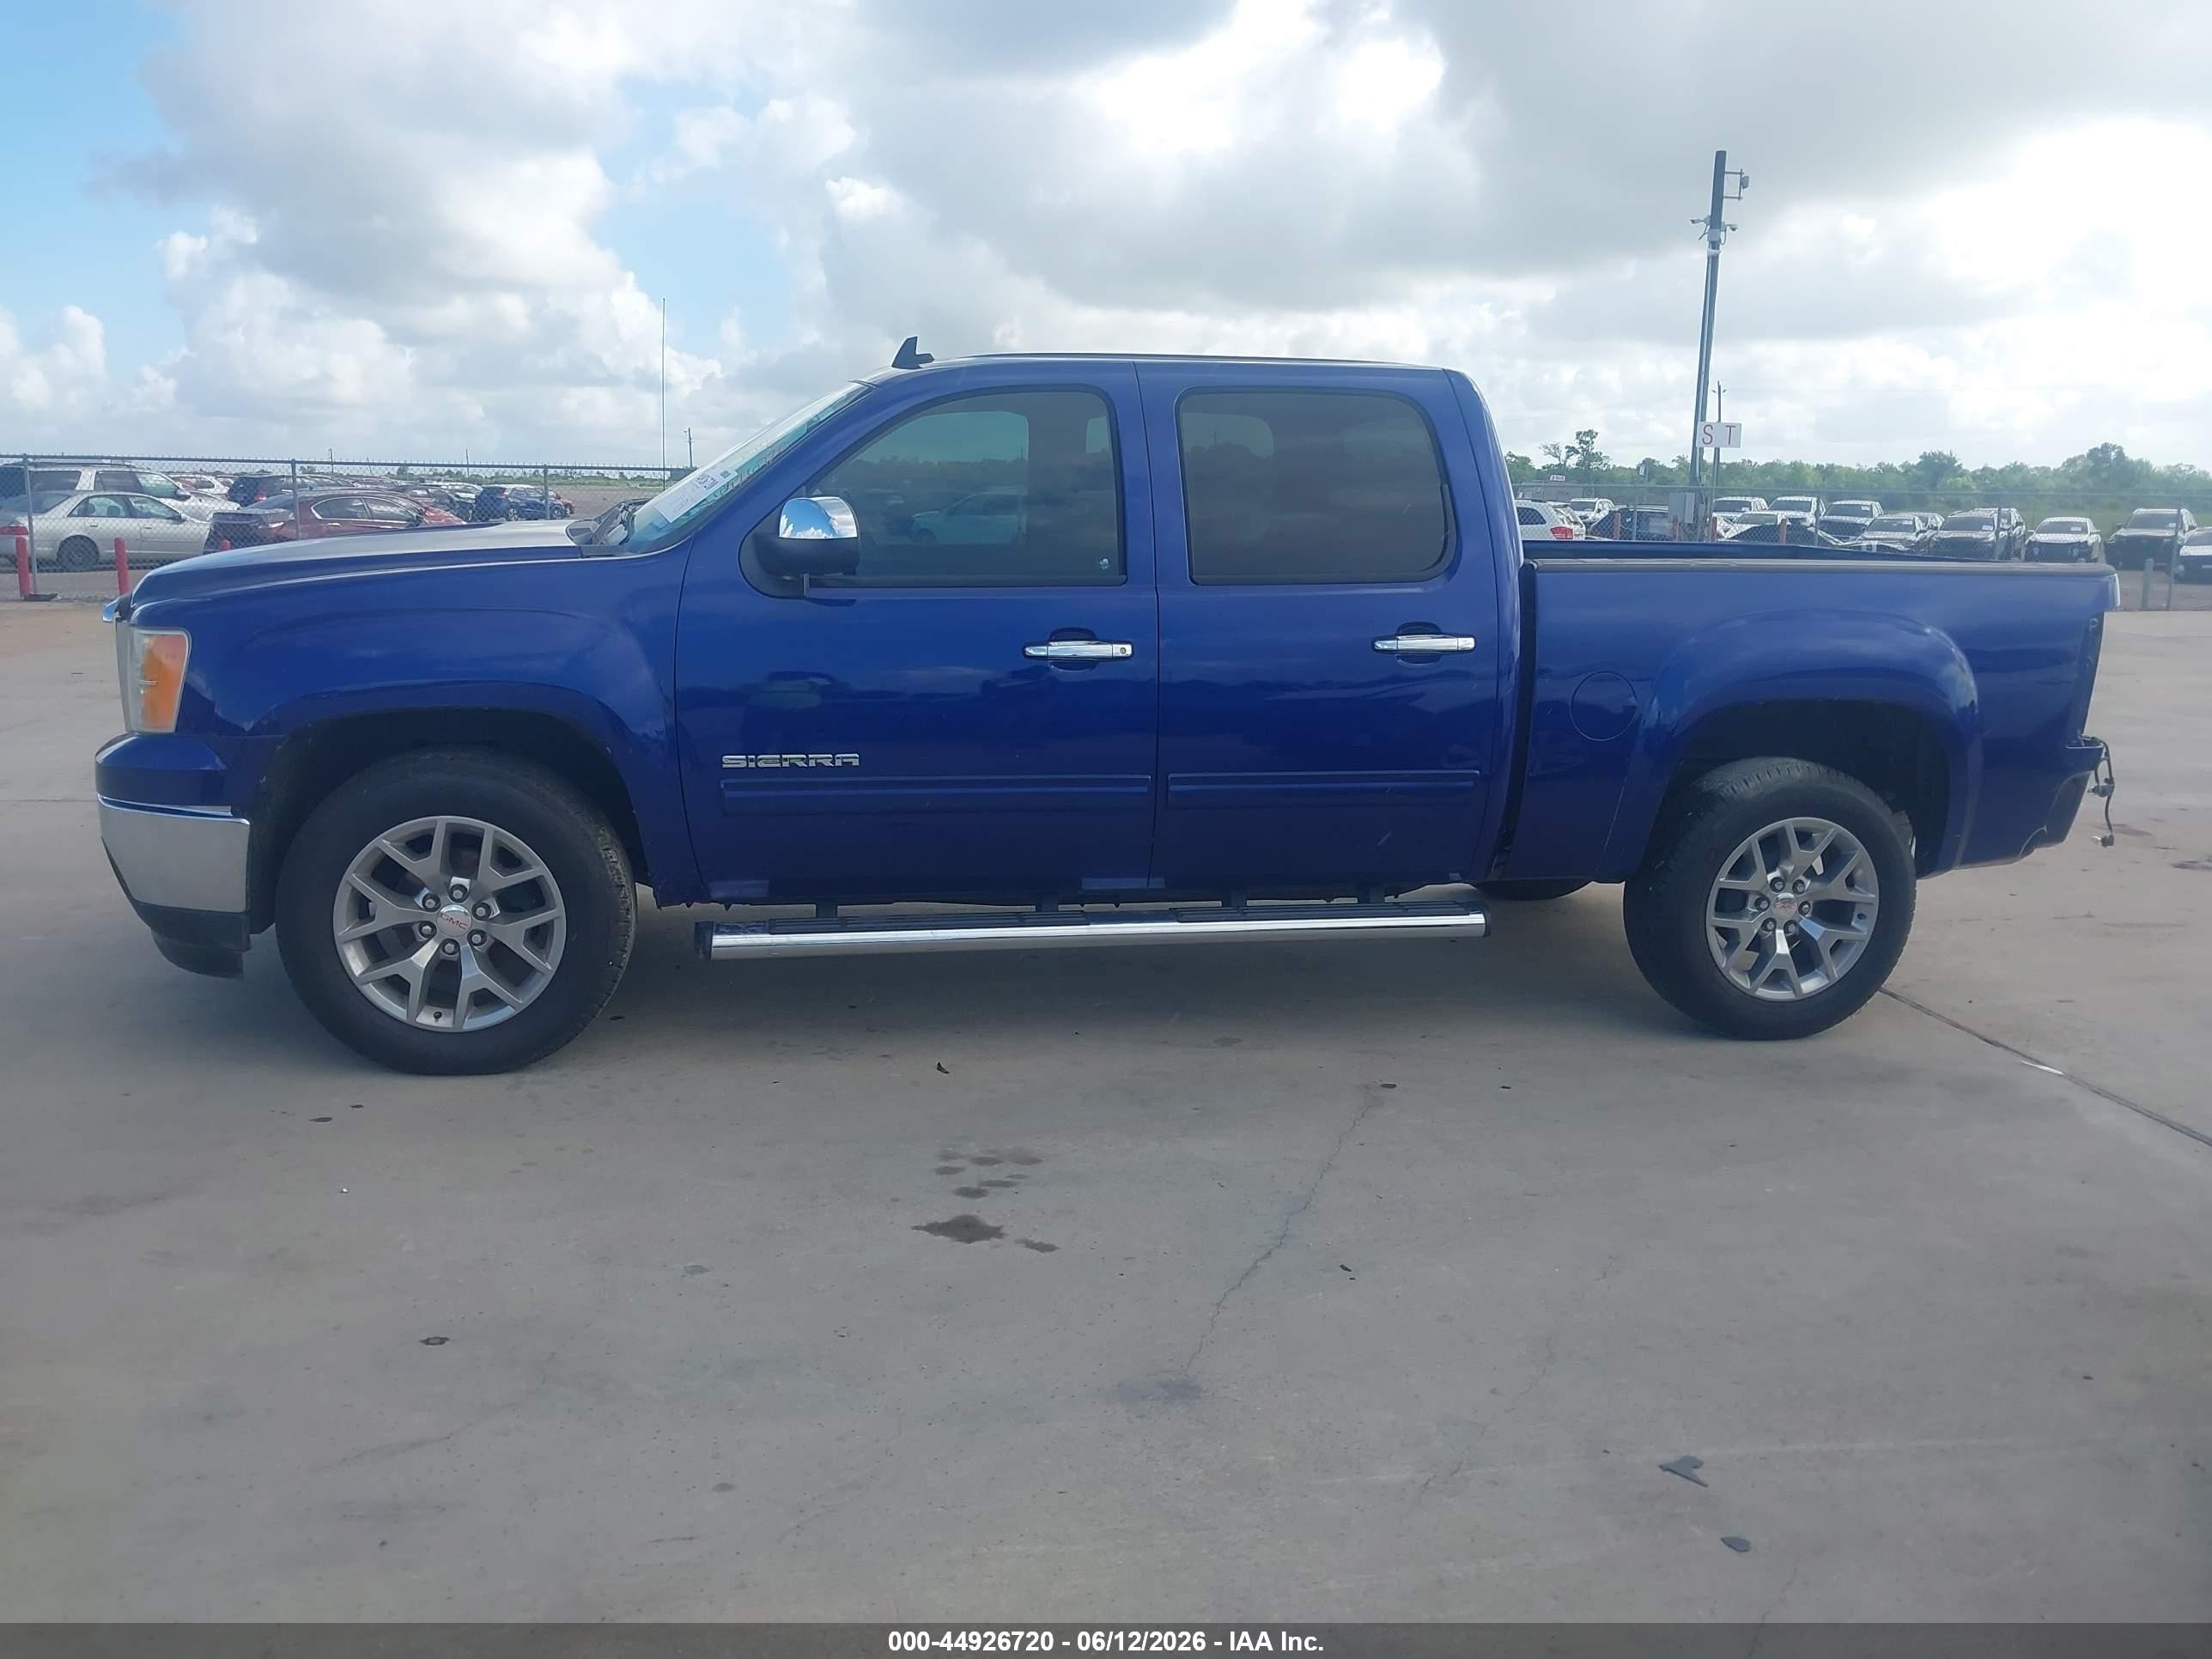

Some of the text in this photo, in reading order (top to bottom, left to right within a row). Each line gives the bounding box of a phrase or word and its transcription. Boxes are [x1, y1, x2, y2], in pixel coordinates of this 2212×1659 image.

[1702, 424, 1736, 446] S T
[722, 753, 860, 769] SIERRA
[440, 913, 468, 930] GMC
